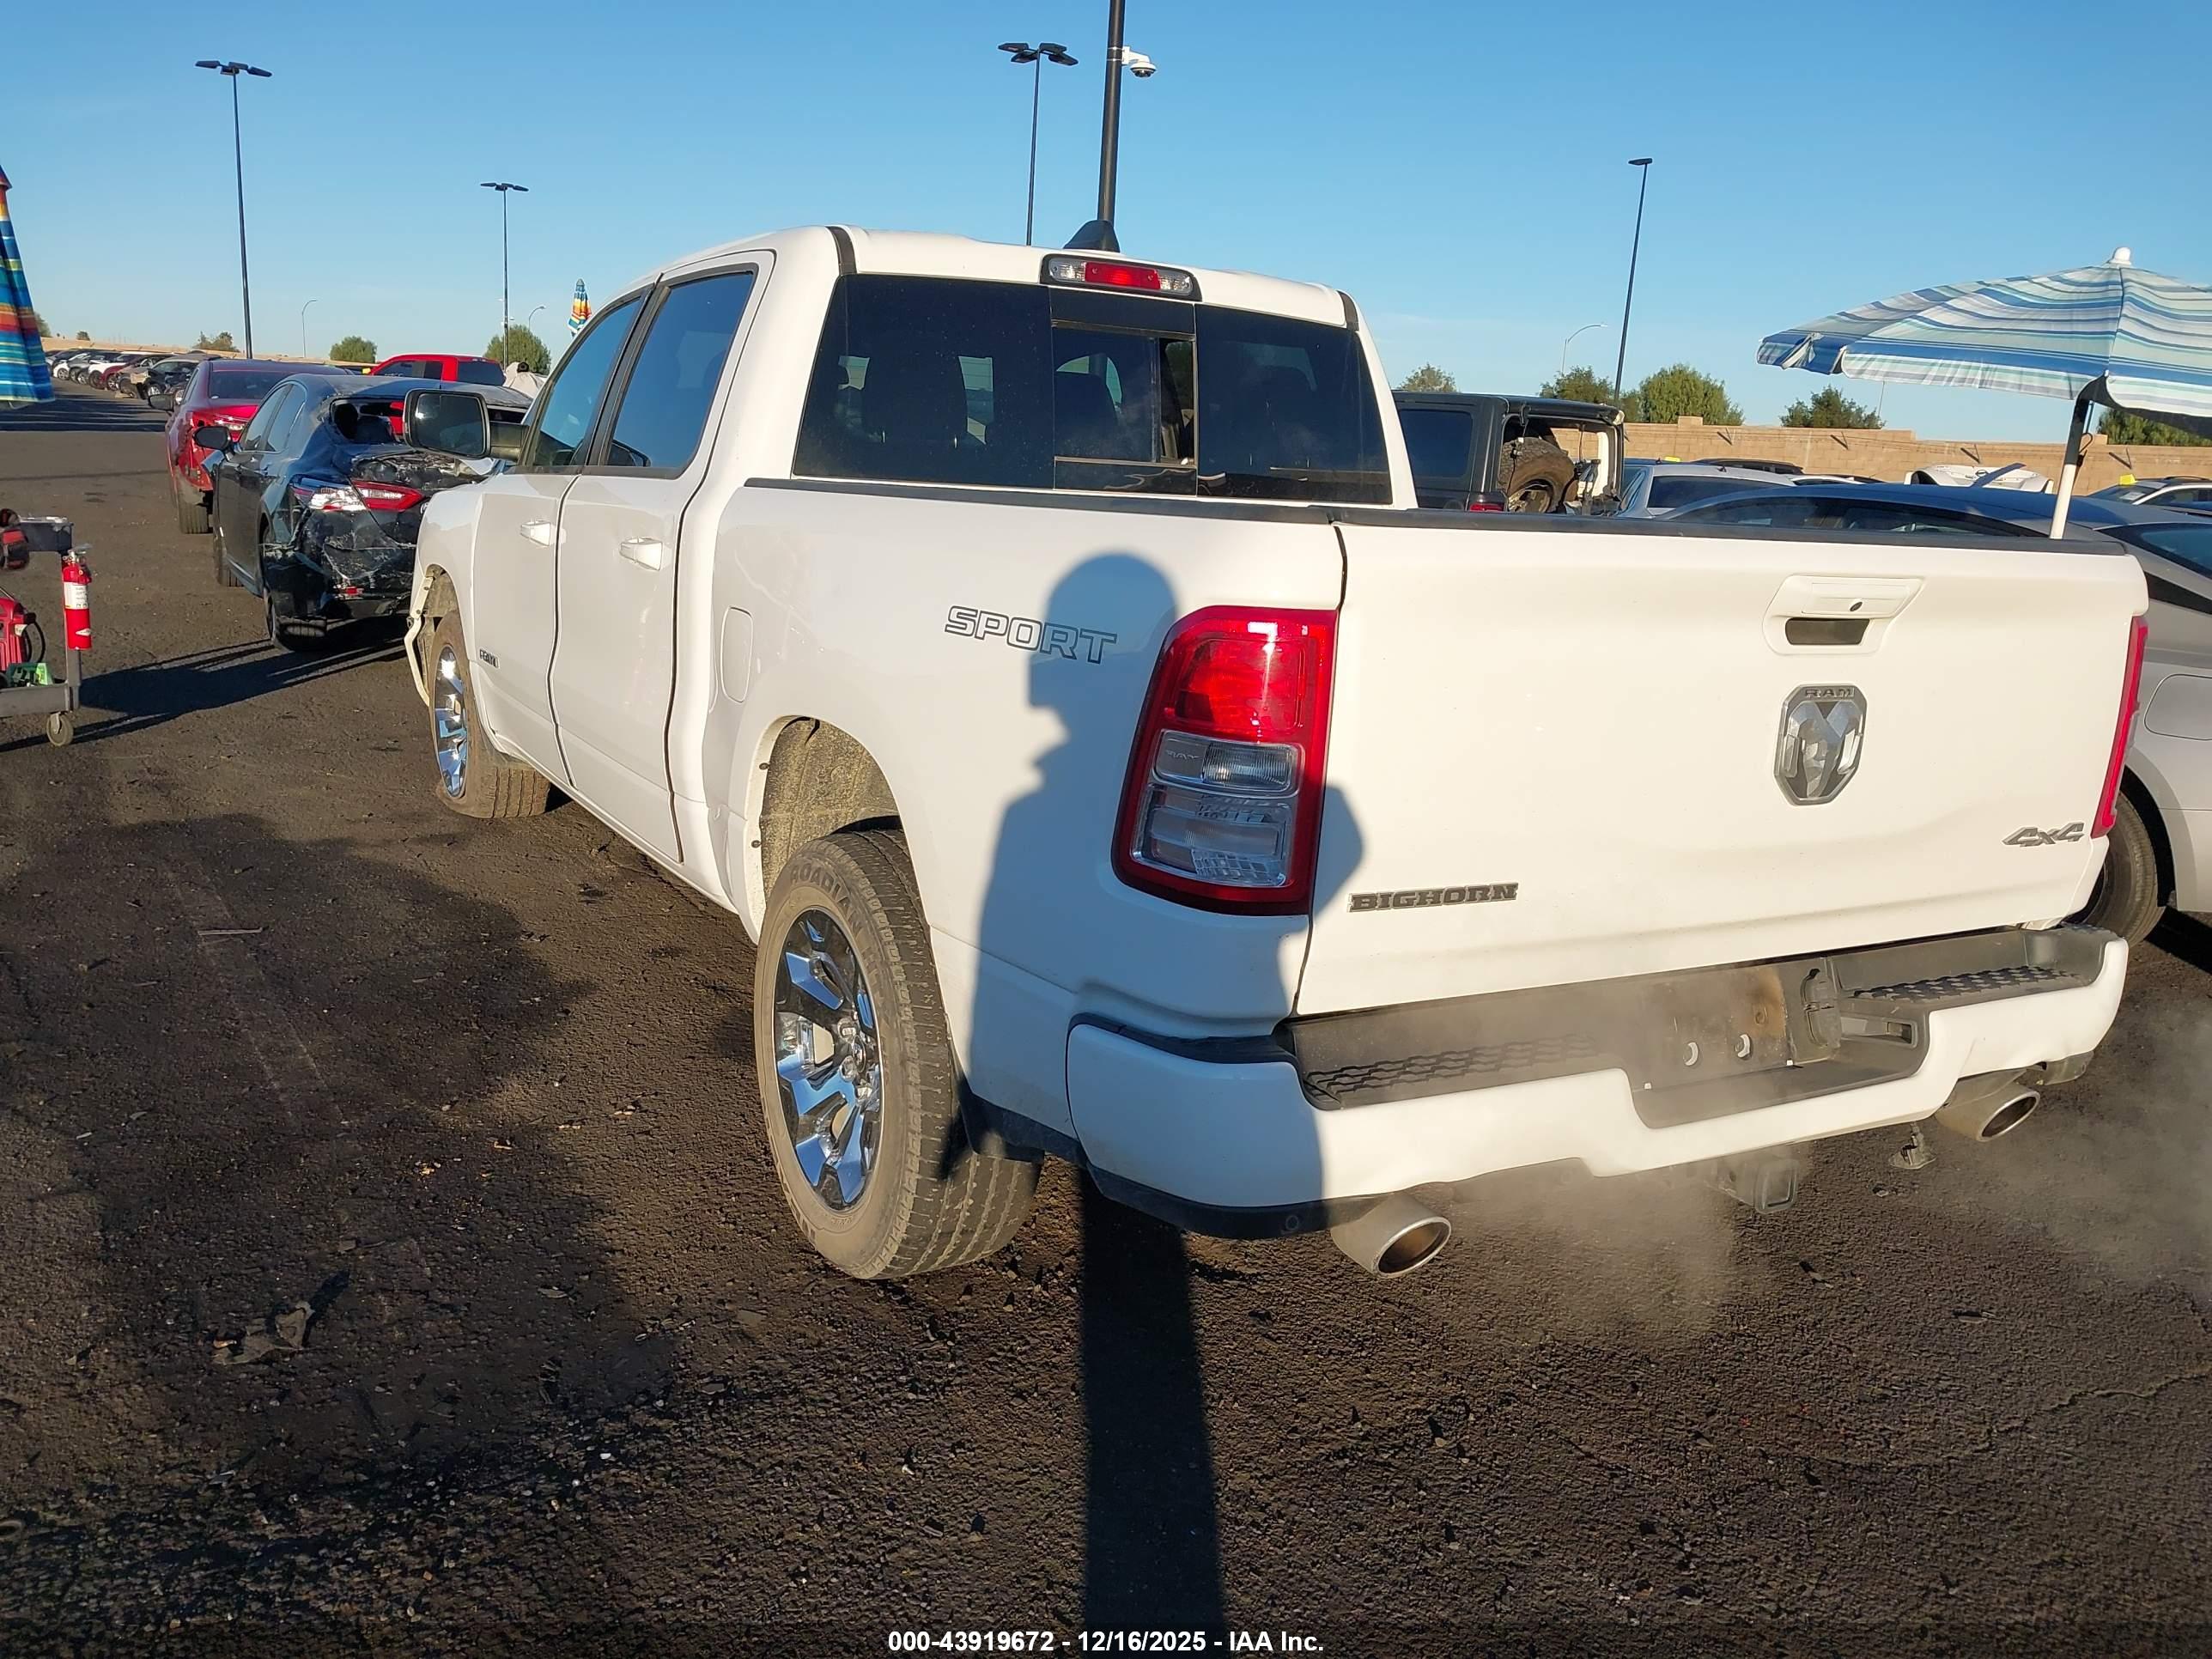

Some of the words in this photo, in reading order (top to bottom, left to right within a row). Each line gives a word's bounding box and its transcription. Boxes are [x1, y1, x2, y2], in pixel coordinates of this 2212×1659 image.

[945, 605, 1117, 664] SPORT
[1805, 688, 1855, 697] RAM
[1349, 882, 1518, 912] BIGHORN
